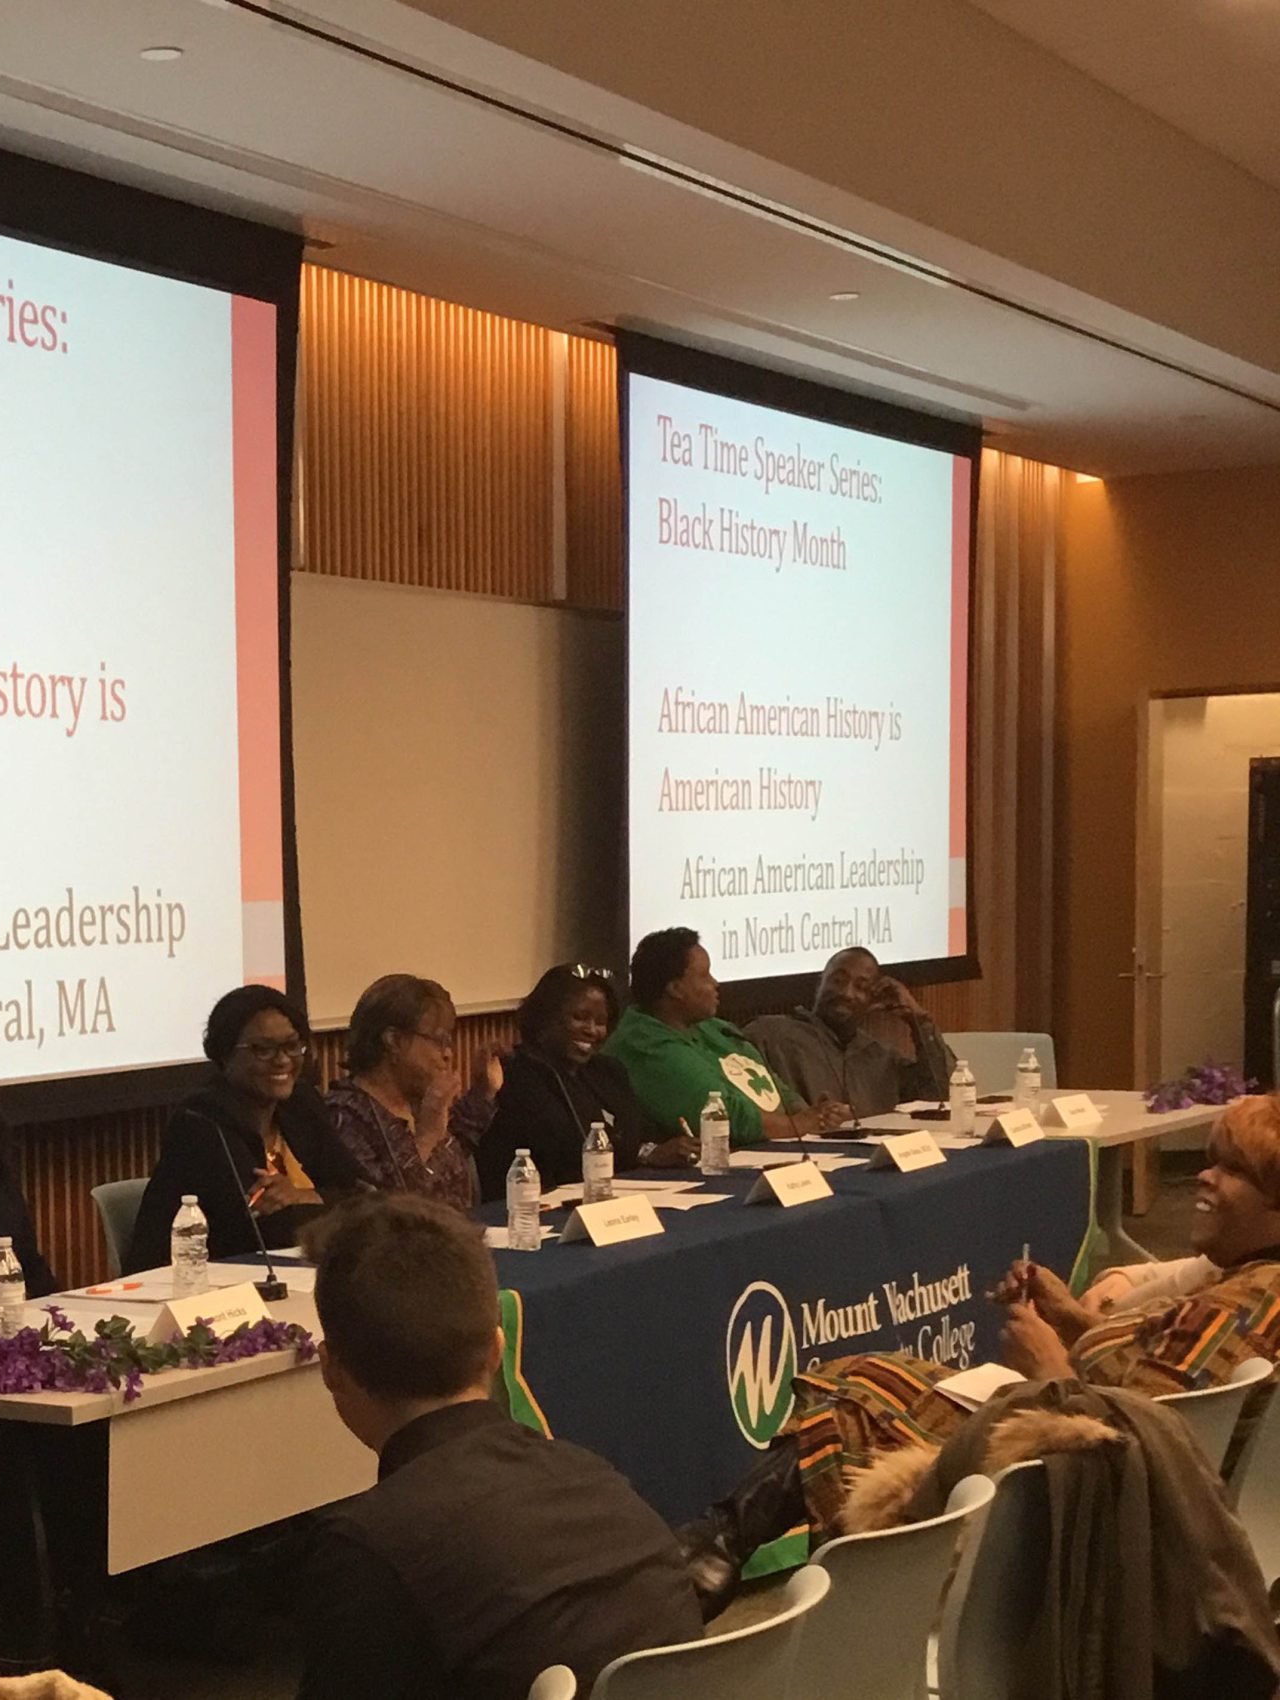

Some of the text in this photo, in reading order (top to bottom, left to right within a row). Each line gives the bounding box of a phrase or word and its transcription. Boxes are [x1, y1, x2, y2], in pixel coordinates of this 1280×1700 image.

[657, 414, 882, 504] Tea Time Speaker Series:
[658, 497, 846, 573] Black History Month
[99, 662, 126, 722] is
[658, 686, 902, 752] African American History is
[658, 767, 822, 821] American History
[680, 847, 924, 900] African American Leadership
[721, 920, 739, 960] in
[745, 912, 795, 957] North
[867, 906, 893, 945] MA
[56, 977, 116, 1037] MA
[801, 1292, 882, 1349] Mount
